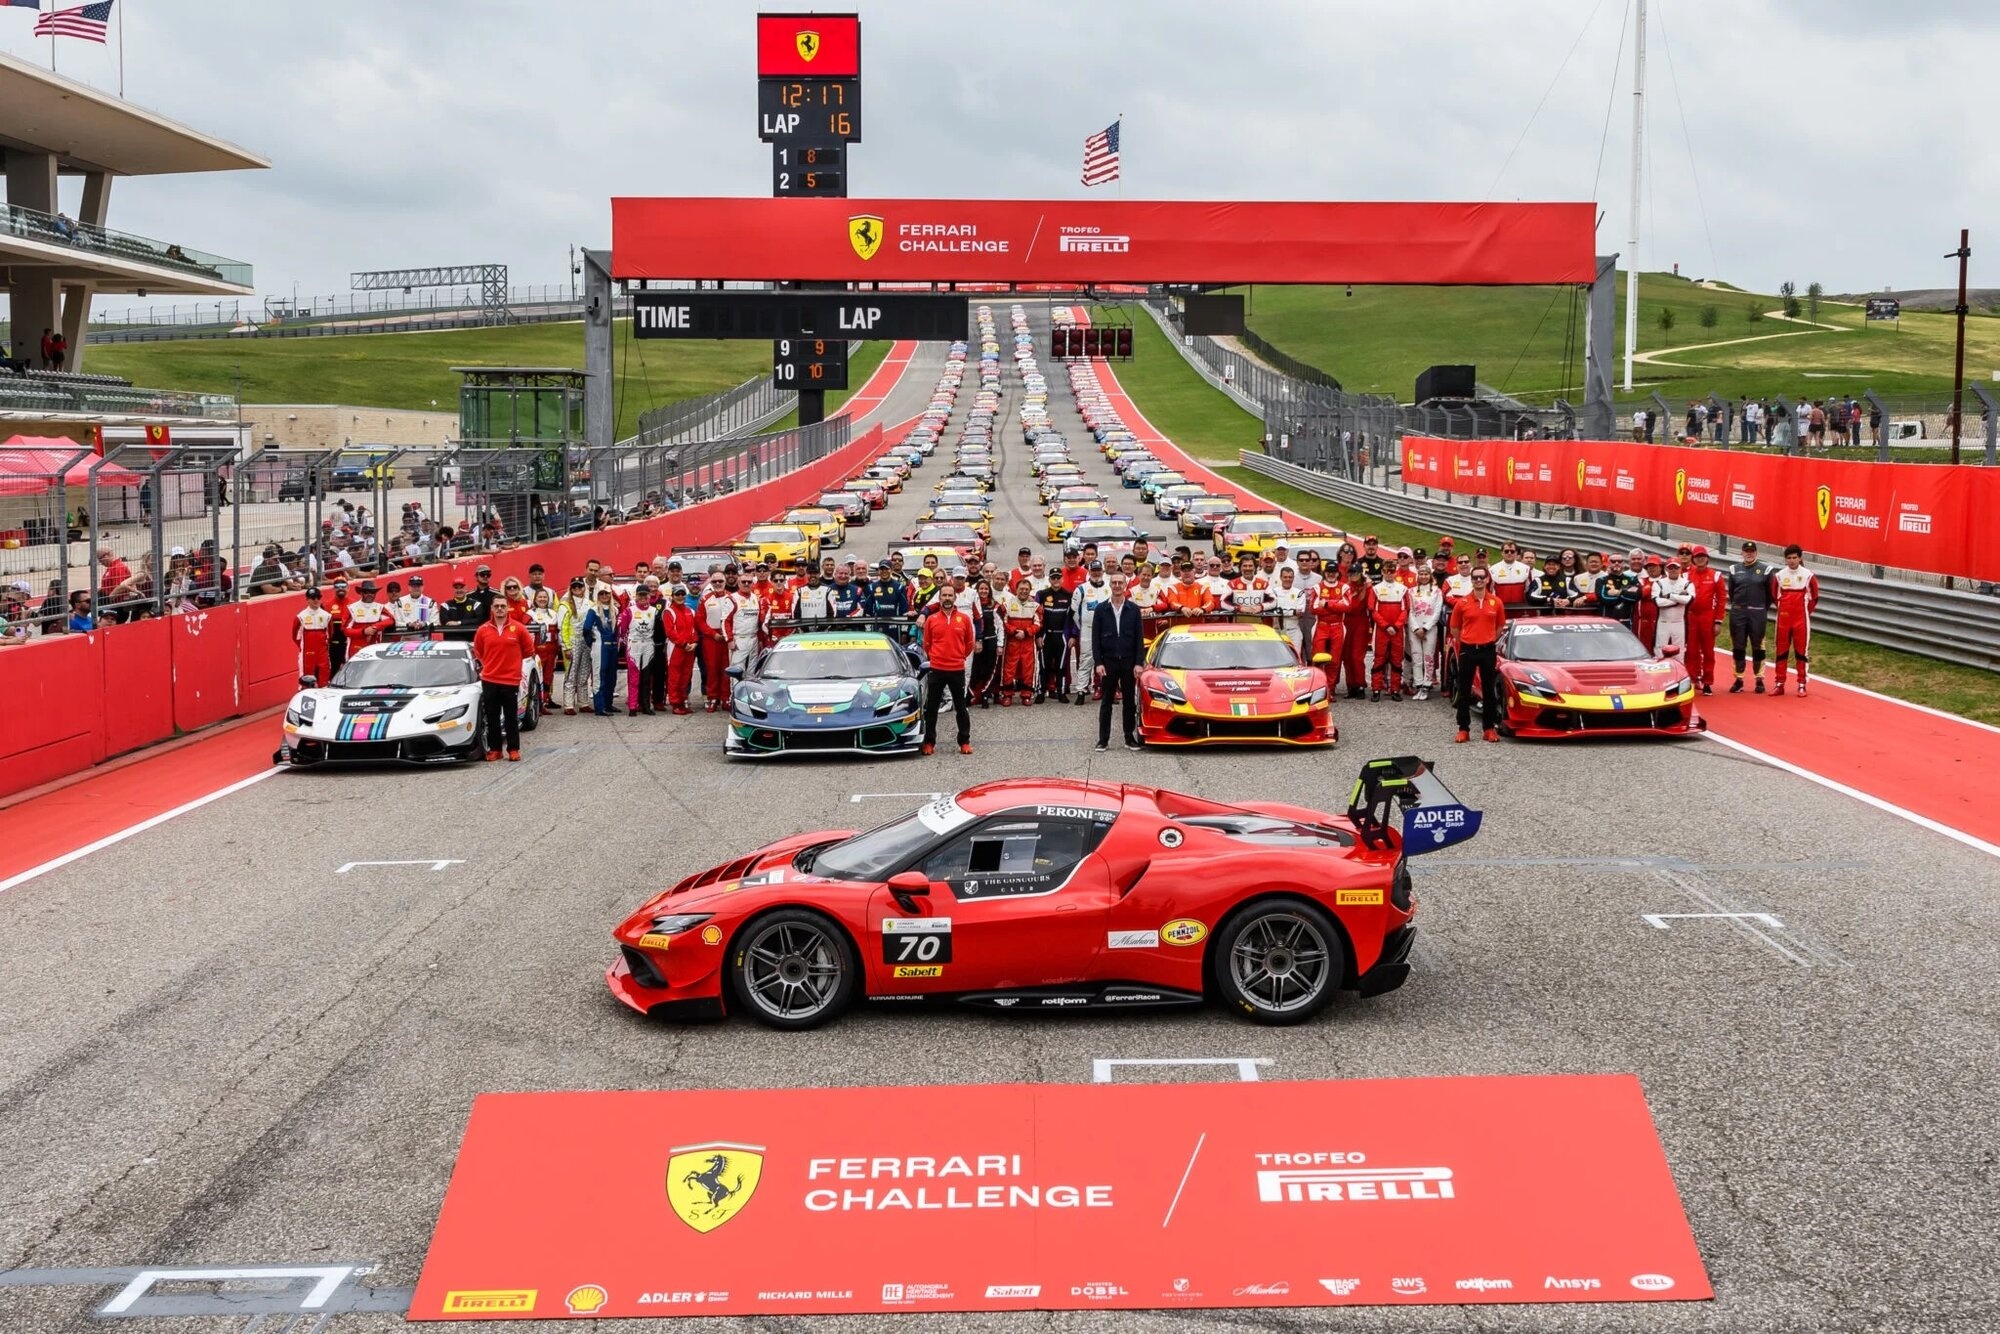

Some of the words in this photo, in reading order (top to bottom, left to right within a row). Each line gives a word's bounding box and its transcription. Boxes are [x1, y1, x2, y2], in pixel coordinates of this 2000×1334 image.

[782, 84, 843, 106] 12:17
[763, 114, 800, 133] LAP
[831, 113, 850, 134] 16
[779, 148, 788, 165] 1
[807, 149, 816, 163] 8
[779, 173, 789, 189] 2
[807, 173, 816, 187] 5
[899, 225, 977, 236] FERRARI
[899, 241, 1009, 252] CHALLENGE
[1060, 235, 1130, 252] PIRELLI
[637, 306, 690, 328] TIME
[839, 307, 881, 329] LAP
[780, 340, 790, 356] 9
[815, 340, 824, 355] 9
[775, 363, 795, 380] 10
[809, 363, 823, 379] 10
[1687, 477, 1710, 489] FERRARI
[1687, 491, 1719, 504] CHALLENGE
[1732, 491, 1754, 510] PIRELLI
[1835, 496, 1866, 510] FERRARI
[1901, 503, 1918, 511] TROFEO
[1835, 512, 1879, 529] CHALLENGE
[1899, 512, 1931, 534] PIRELLI
[1552, 623, 1614, 631] DOBEL
[386, 649, 450, 657] DOBEL
[1036, 805, 1093, 819] PERONI
[1413, 810, 1464, 823] ADLER
[984, 877, 1002, 885] THE
[1003, 875, 1051, 884] CONCOURS
[1001, 885, 1034, 893] CLUB
[1340, 892, 1379, 902] PIRELLI
[1167, 926, 1200, 939] PENNZOIL
[641, 936, 667, 947] PIRELLI
[897, 936, 940, 961] 70
[898, 967, 937, 977] Sabelt
[1042, 997, 1087, 1006] rotiform
[1104, 994, 1160, 1002] @FerrariRaces
[1256, 1153, 1366, 1165] TROFEO
[807, 1156, 1021, 1179] FERRARI
[1255, 1167, 1456, 1202] PIRELLI
[803, 1184, 1113, 1212] CHALLENGE
[1392, 1277, 1424, 1287] aws
[1456, 1278, 1513, 1292] rotiform
[1544, 1277, 1601, 1291] Ansys
[1637, 1278, 1668, 1286] BELL
[758, 1291, 813, 1300] RICHARD
[816, 1290, 853, 1299] MILLE
[1071, 1286, 1128, 1295] DOBEL
[451, 1294, 528, 1308] PIRELLI
[637, 1292, 691, 1304] ADLER
